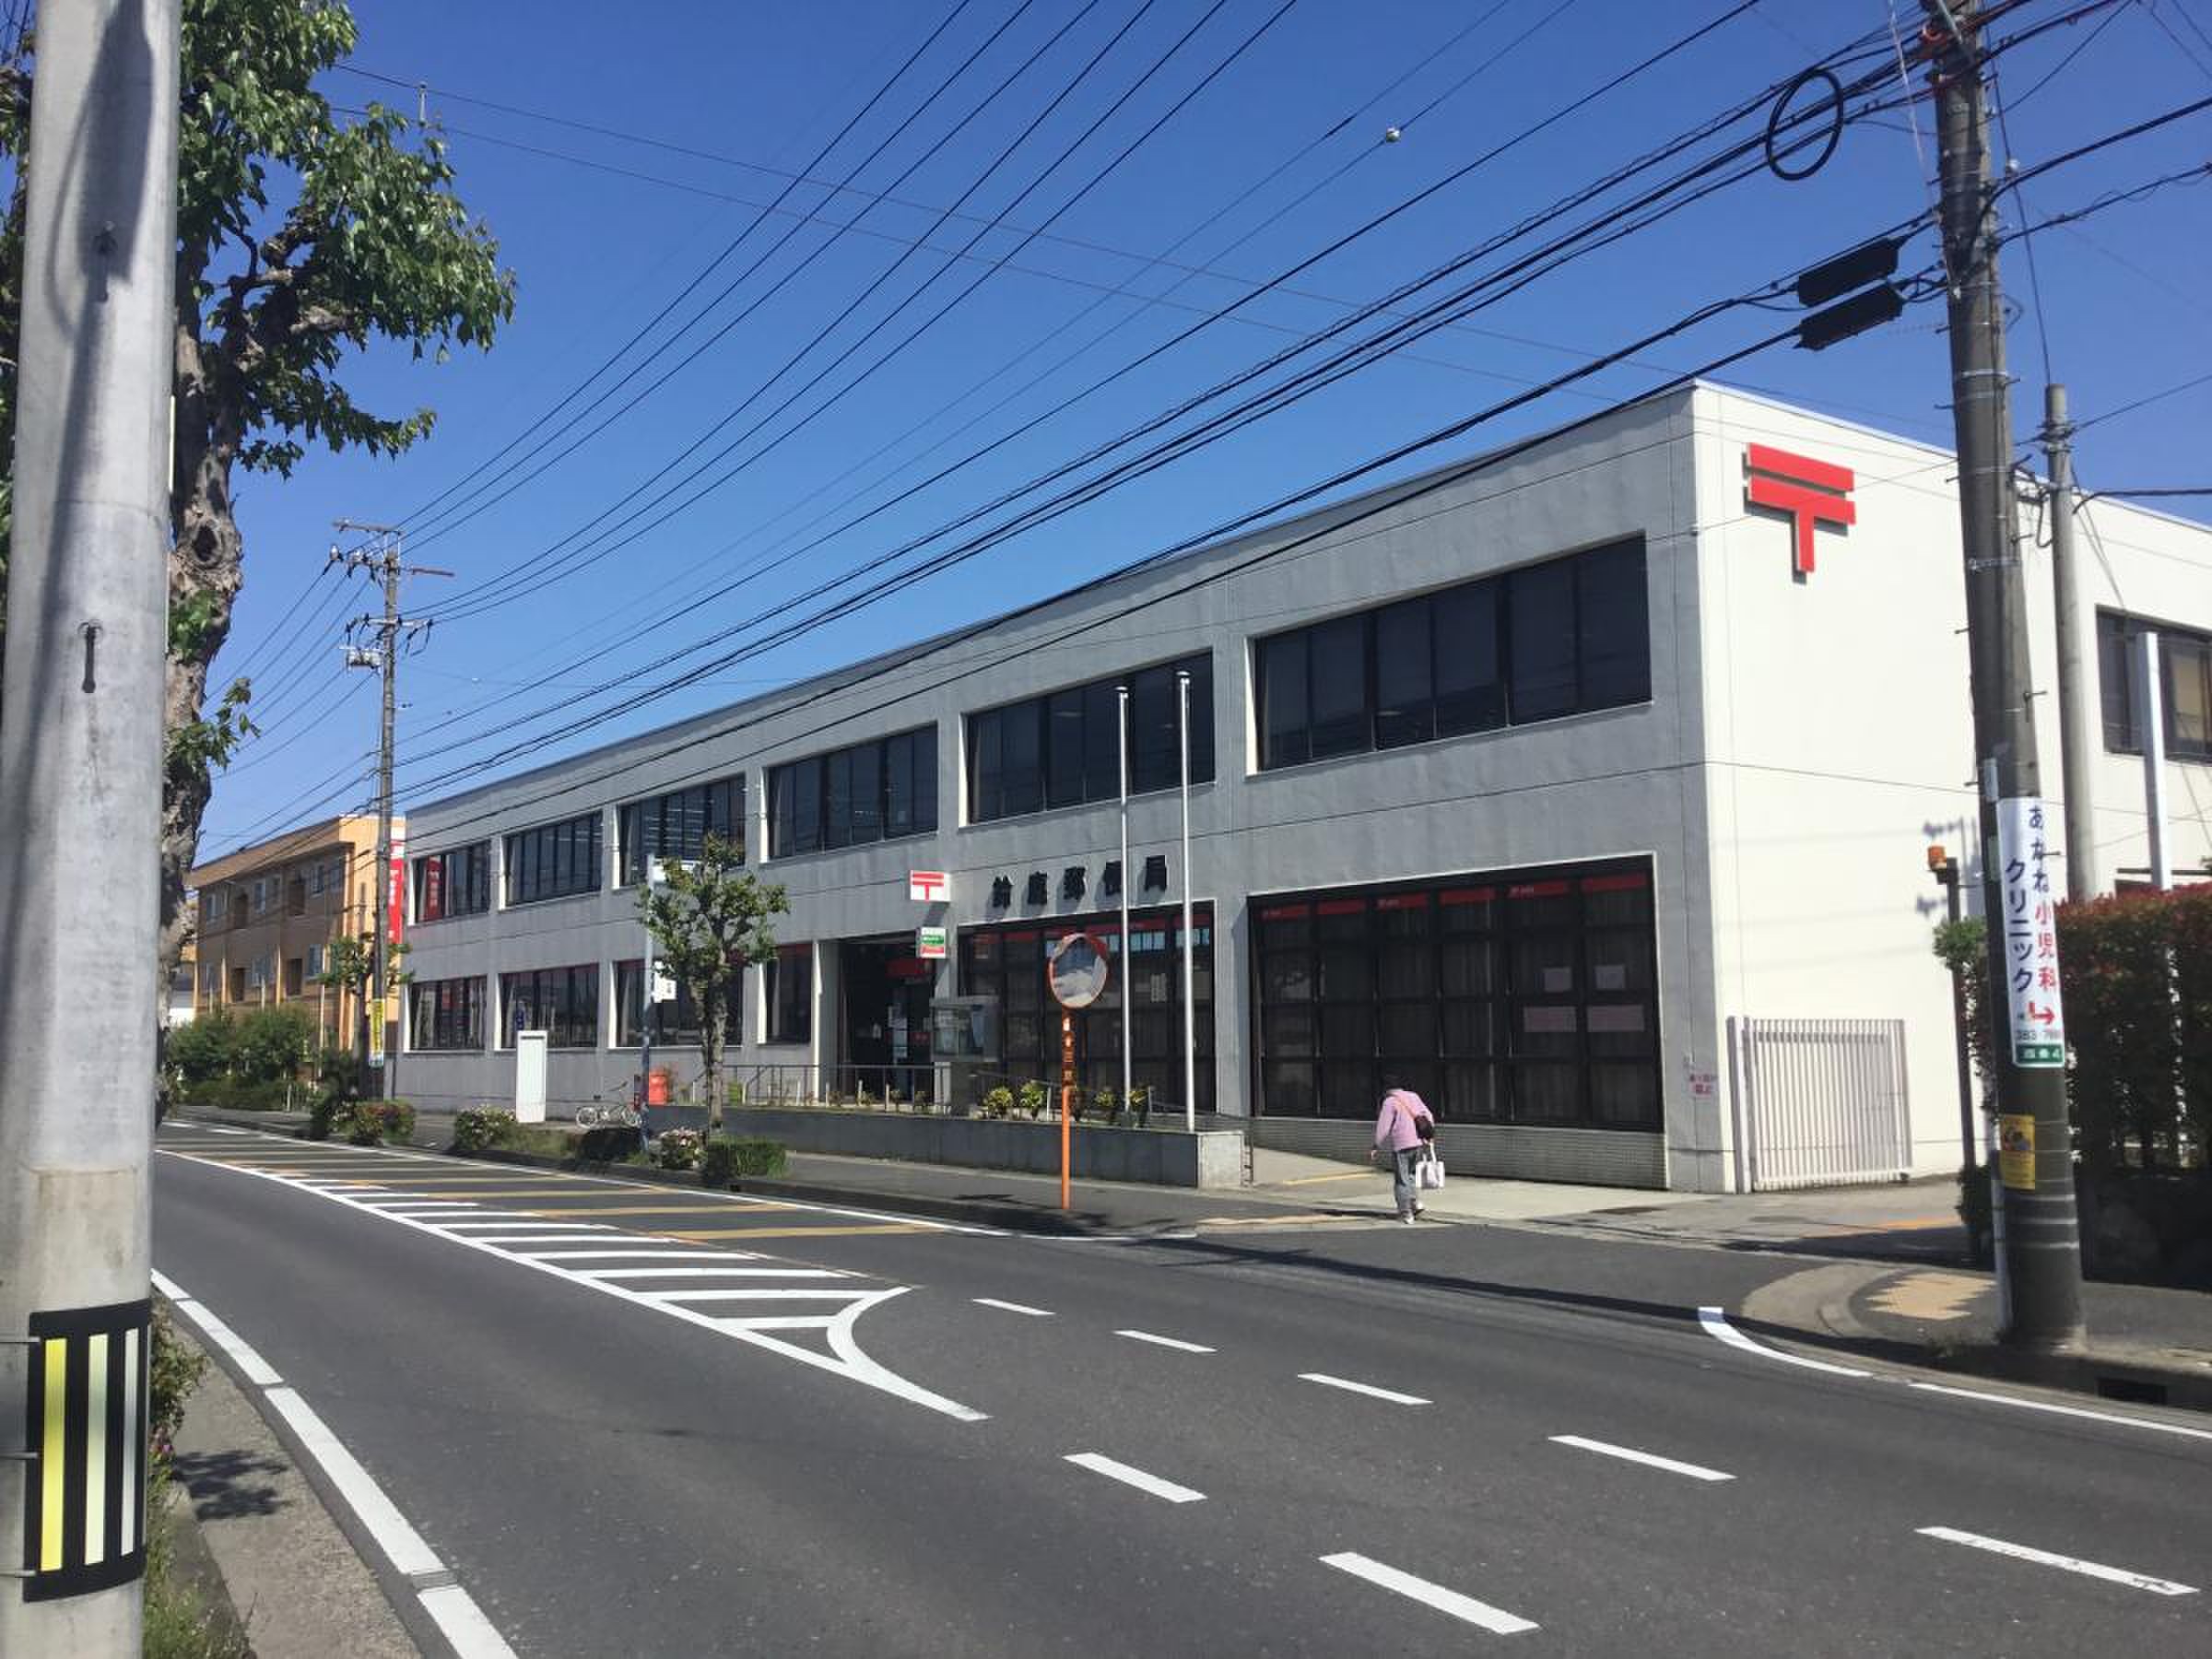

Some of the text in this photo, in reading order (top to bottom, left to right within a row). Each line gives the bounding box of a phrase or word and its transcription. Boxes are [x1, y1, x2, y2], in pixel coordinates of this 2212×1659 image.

[2005, 857, 2033, 993] クリニック
